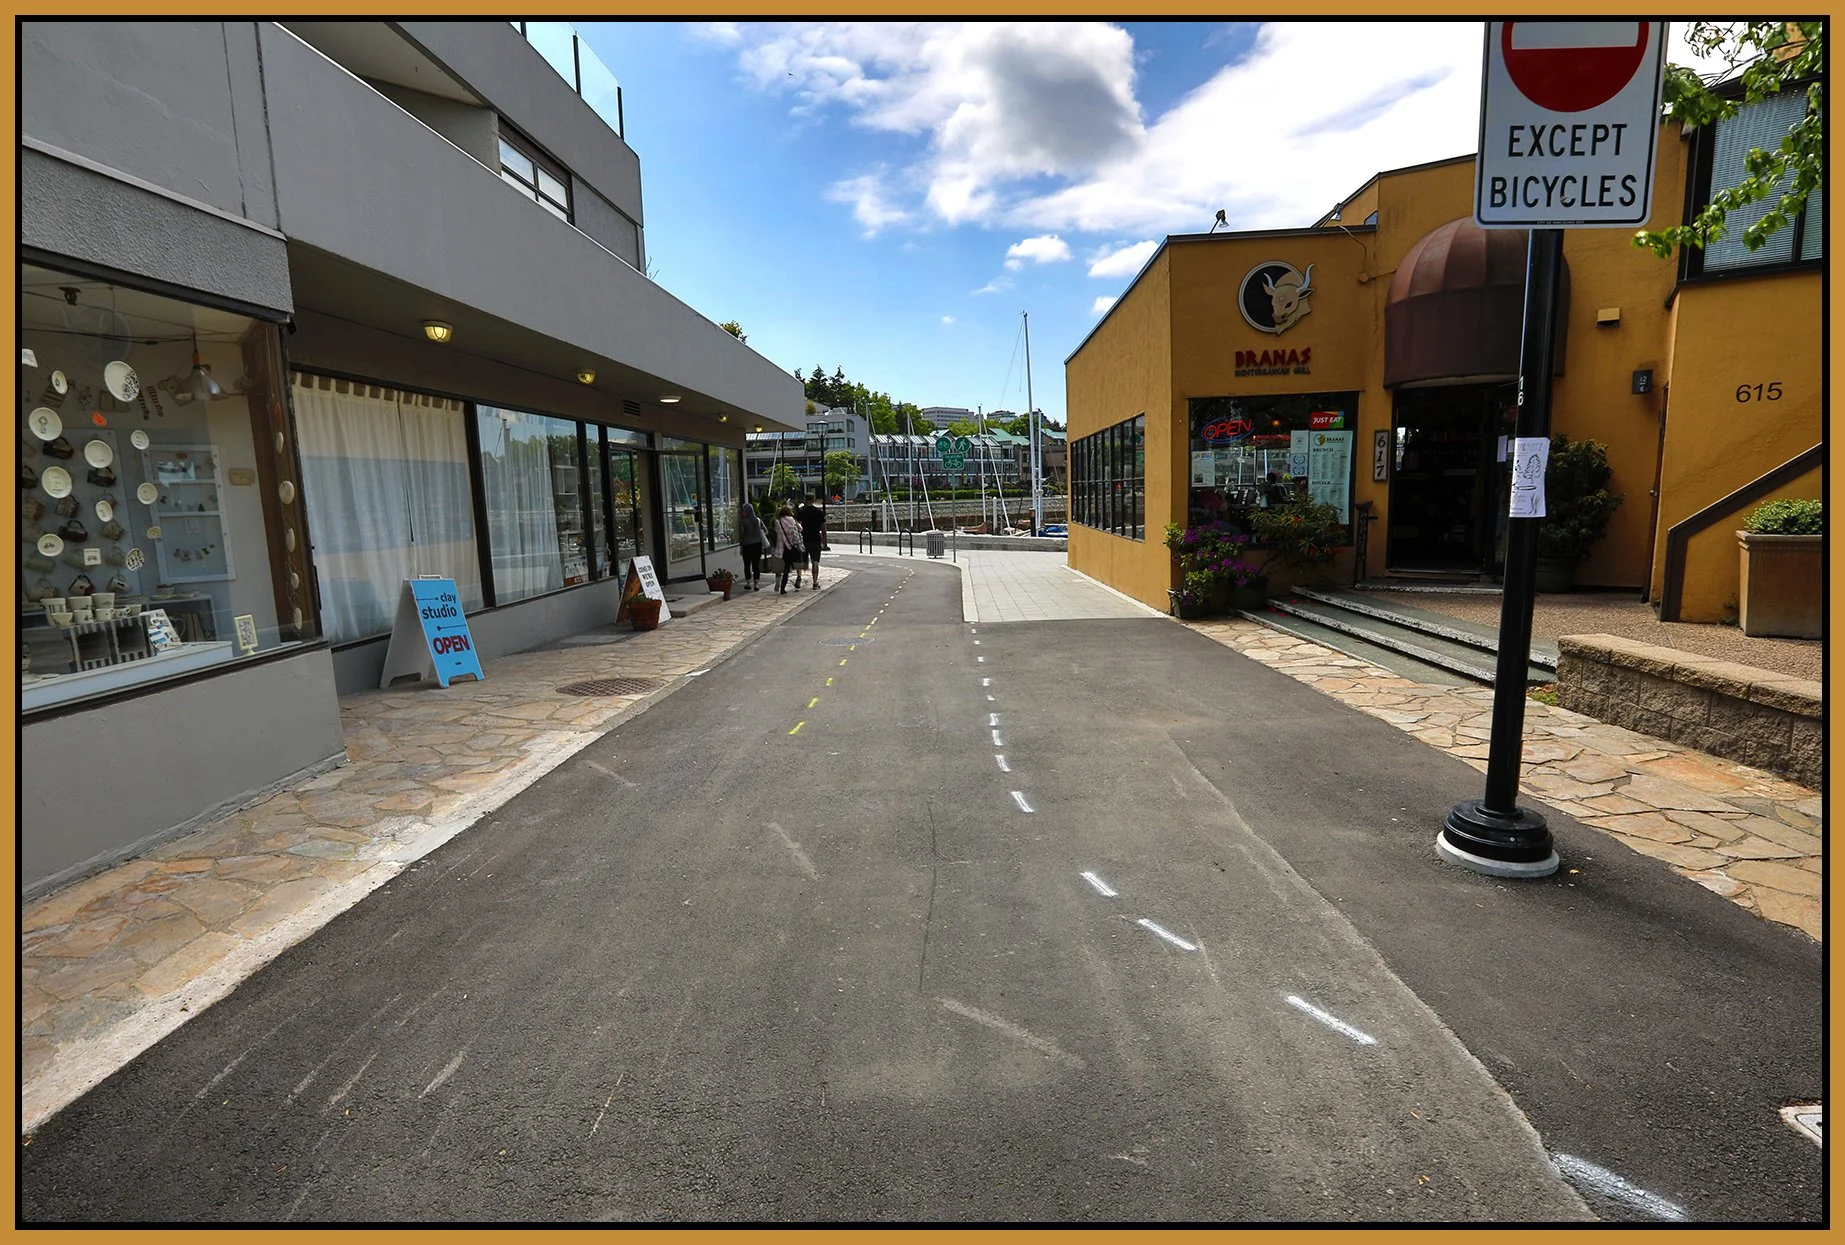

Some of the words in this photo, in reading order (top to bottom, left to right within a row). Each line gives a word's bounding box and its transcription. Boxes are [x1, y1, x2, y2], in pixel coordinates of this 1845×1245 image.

[1508, 123, 1628, 158] EXCEPT
[1489, 173, 1637, 209] BICYCLES
[1235, 347, 1312, 368] BRANAS
[1735, 381, 1783, 403] 615
[1203, 418, 1252, 440] OPEN
[1312, 416, 1328, 425] JUST
[1329, 416, 1342, 424] EAT
[1376, 435, 1386, 477] 617
[440, 592, 457, 604] clay
[421, 603, 458, 620] studio
[432, 634, 471, 655] OPEN
